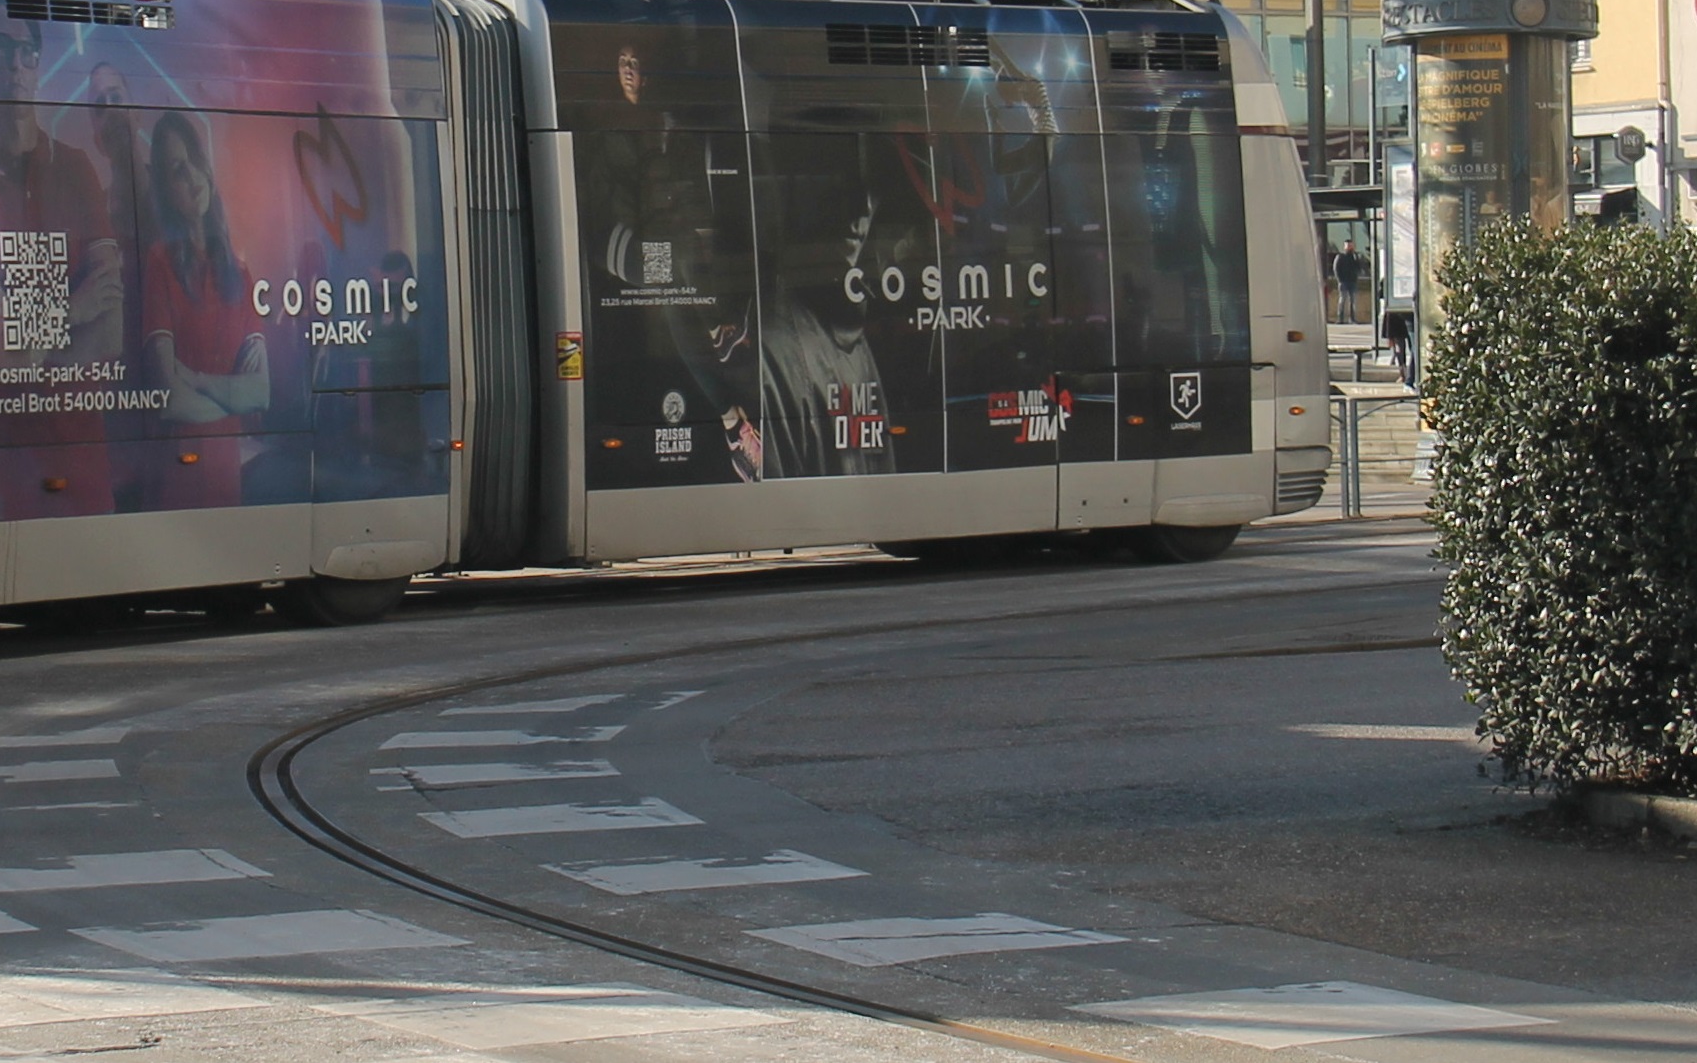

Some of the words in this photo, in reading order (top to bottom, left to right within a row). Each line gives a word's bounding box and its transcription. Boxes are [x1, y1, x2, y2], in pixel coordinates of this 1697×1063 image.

[1442, 82, 1503, 95] D'AMOUR
[1449, 162, 1498, 174] GLOBES
[843, 262, 1049, 304] COSMIC
[252, 277, 419, 316] COSMIC
[28, 393, 61, 413] Brot
[64, 391, 114, 411] 54000
[118, 389, 171, 411] NANCY
[826, 382, 879, 416] GAME
[655, 427, 692, 441] PRISON
[835, 415, 884, 449] OVER
[655, 440, 692, 453] ISLAND
